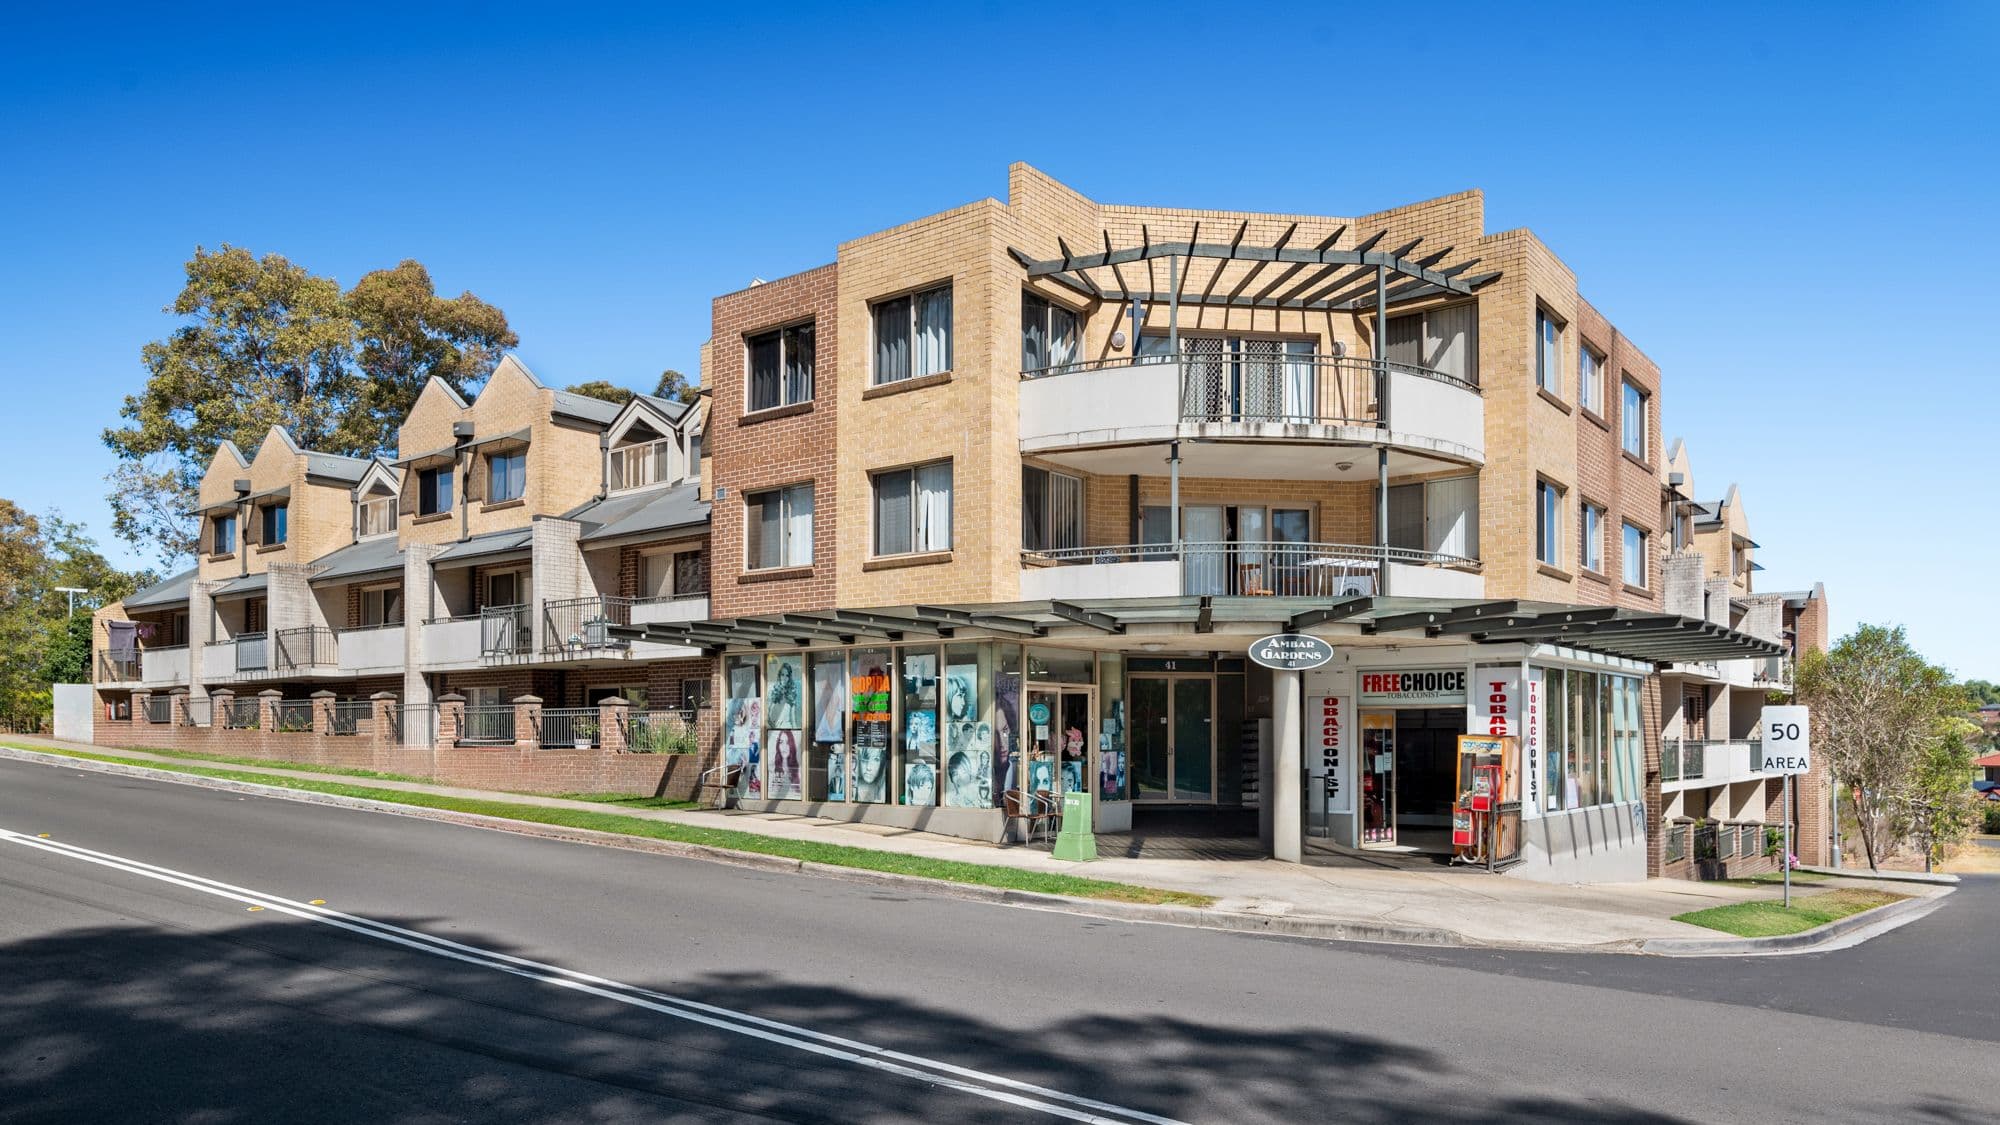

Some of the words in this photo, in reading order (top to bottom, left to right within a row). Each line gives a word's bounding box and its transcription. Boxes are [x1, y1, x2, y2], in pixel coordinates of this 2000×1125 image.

[1268, 638, 1315, 648] AMBAR
[1260, 648, 1322, 659] GARDENS
[1165, 660, 1177, 670] 41
[1362, 671, 1465, 693] FREECHOICE
[1386, 691, 1440, 699] TOBACCONIST
[1771, 723, 1799, 740] 50
[1764, 757, 1807, 768] AREA
